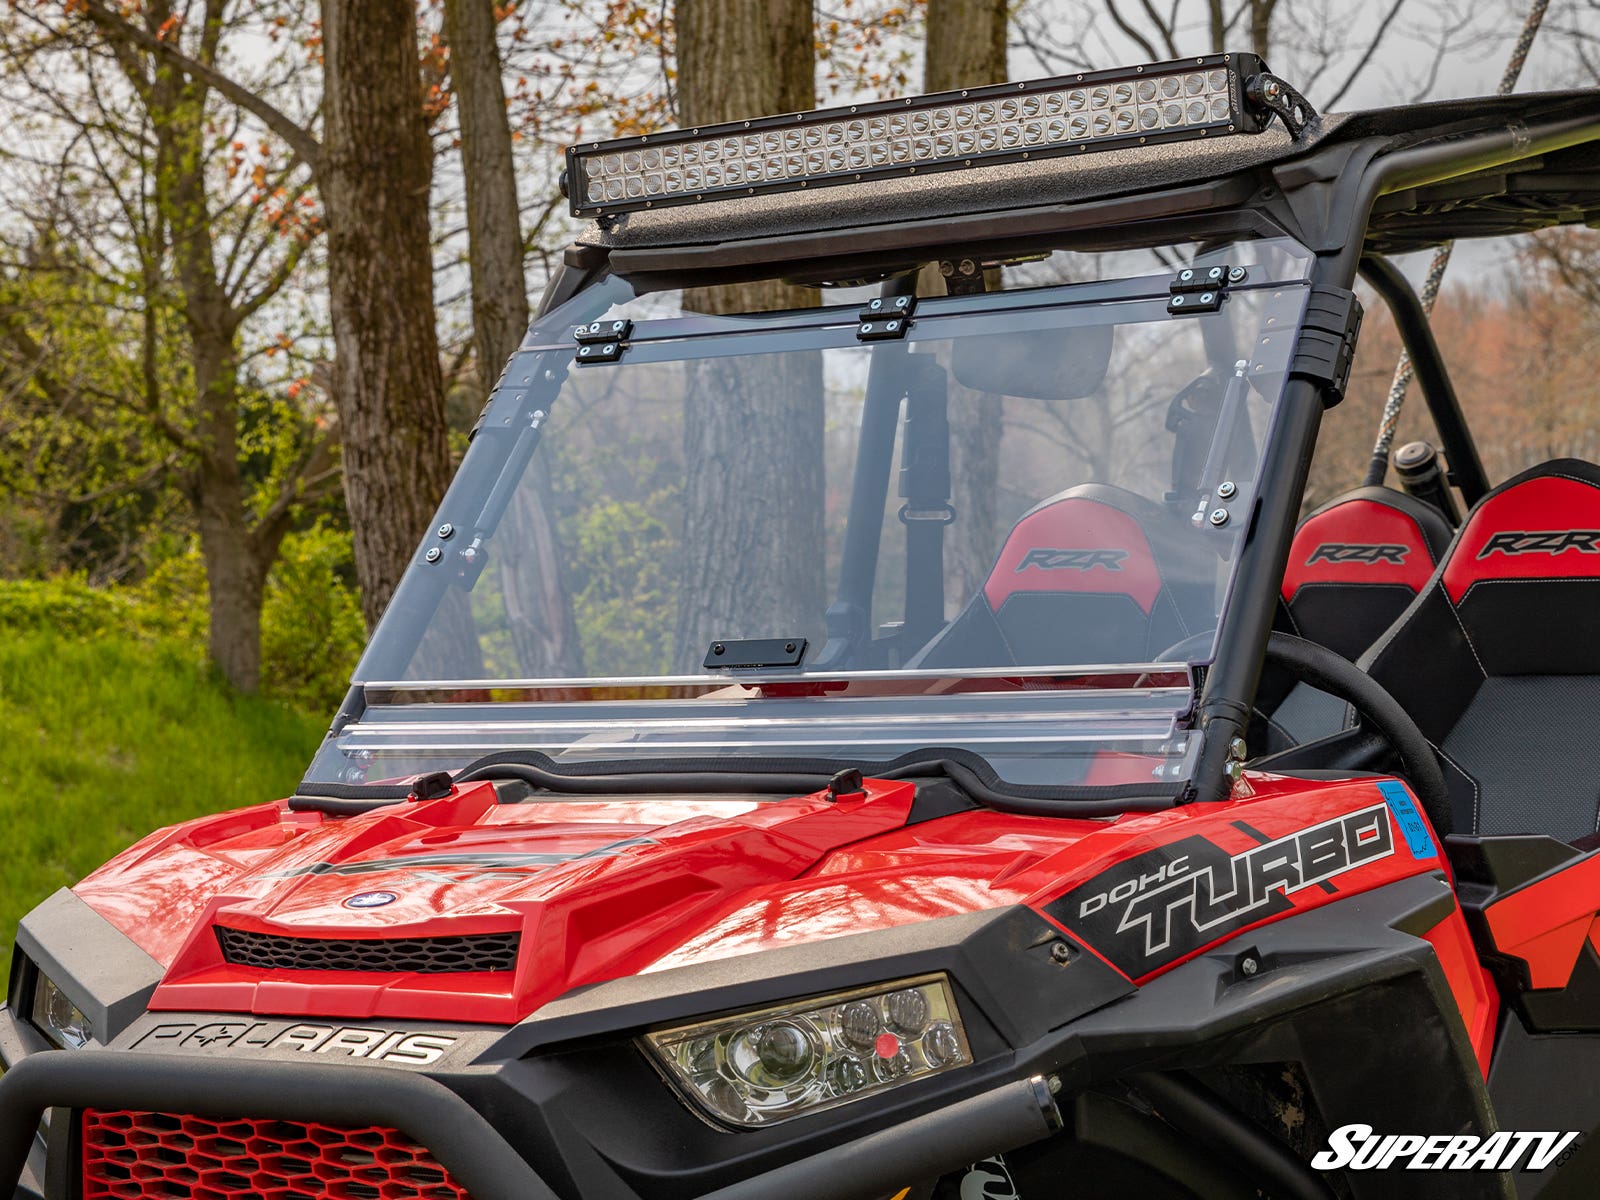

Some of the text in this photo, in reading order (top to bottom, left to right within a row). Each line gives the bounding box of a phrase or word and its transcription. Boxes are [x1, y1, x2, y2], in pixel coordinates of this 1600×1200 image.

[1014, 548, 1129, 573] RZR
[1304, 543, 1411, 567] RZR
[1475, 528, 1600, 561] RZR
[1079, 855, 1190, 918] DOHC
[1116, 802, 1395, 957] TURBO
[128, 1022, 458, 1065] POLARIS
